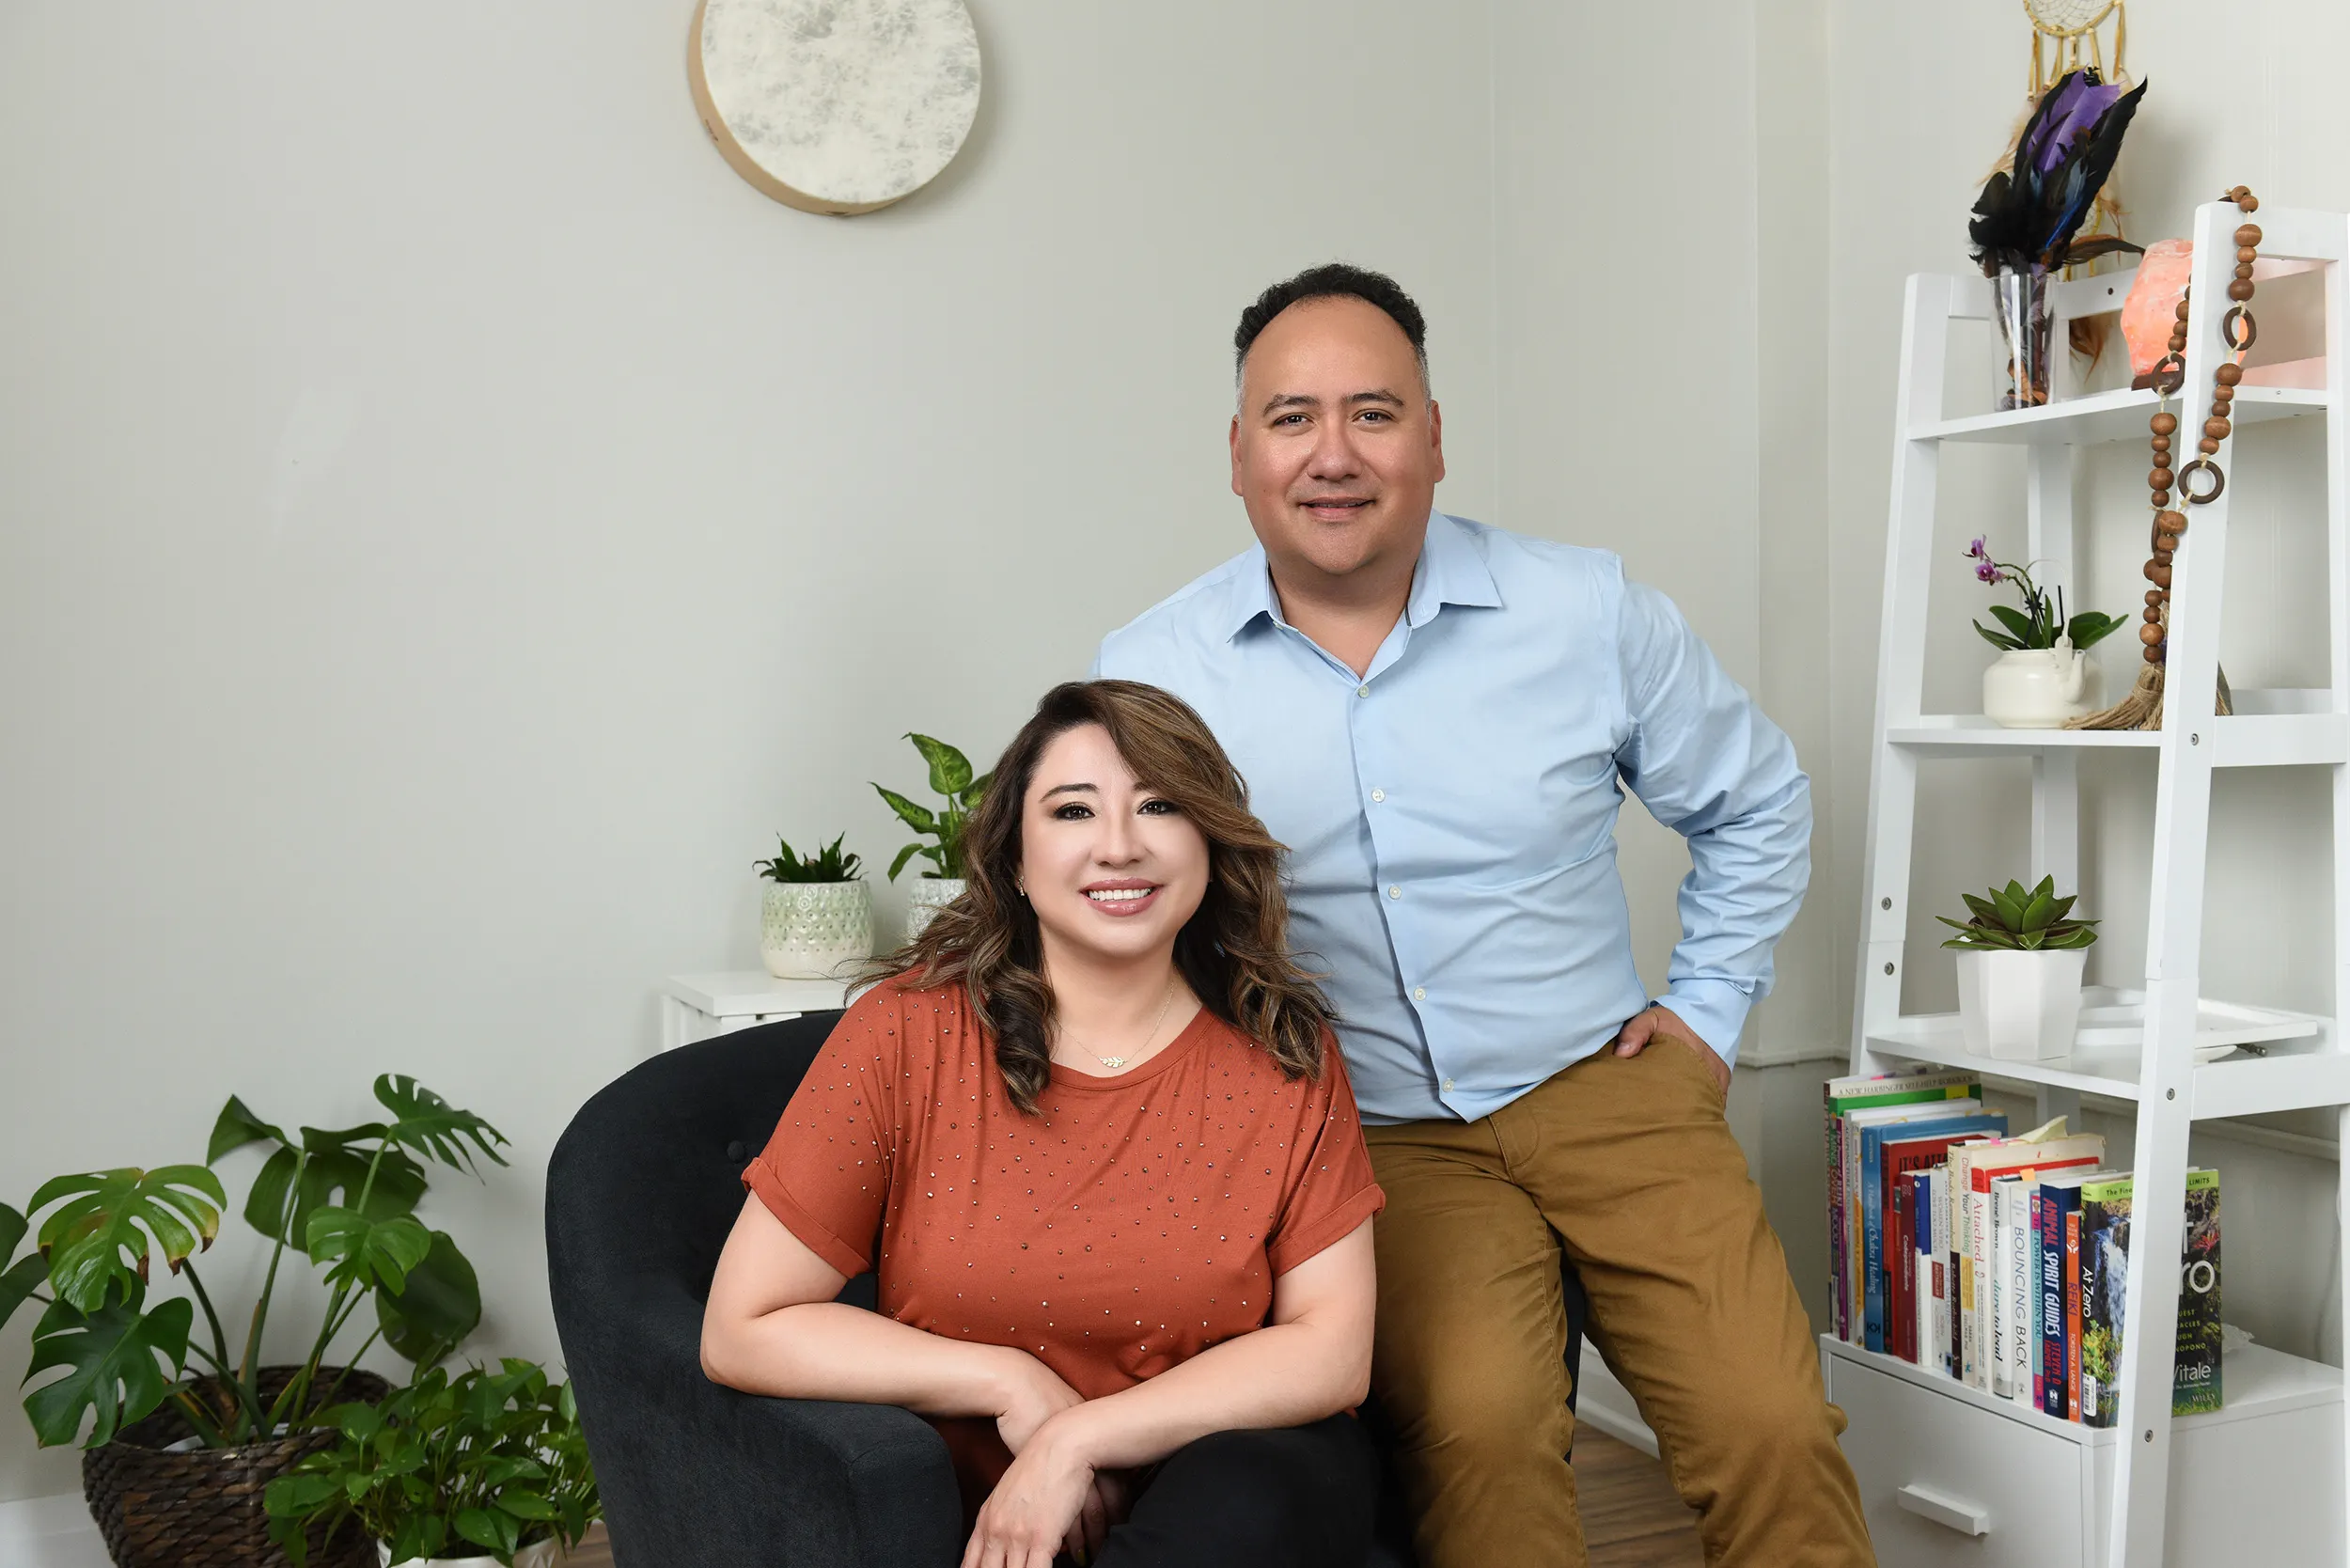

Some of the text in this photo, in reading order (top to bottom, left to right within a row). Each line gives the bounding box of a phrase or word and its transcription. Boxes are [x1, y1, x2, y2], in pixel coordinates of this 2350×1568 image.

[1844, 1087, 1862, 1095] NEW
[1864, 1083, 1904, 1093] HARBINGER
[1899, 1154, 1919, 1172] IT'S
[1961, 1157, 1969, 1191] Change
[2188, 1177, 2210, 1186] LIMITS
[1962, 1193, 1970, 1215] Your
[1868, 1228, 1878, 1260] Chakra
[1962, 1216, 1970, 1253] Thinking
[1973, 1197, 1984, 1266] Attached.
[1867, 1262, 1880, 1294] Healing
[2014, 1226, 2027, 1320] BOUNCING
[2043, 1197, 2060, 1337] ANIMAL SPIRIT GUIDES
[1993, 1279, 2001, 1312] dare
[2068, 1281, 2078, 1316] REIKI
[2082, 1266, 2094, 1318] At Zero
[1994, 1315, 2000, 1328] to
[2180, 1320, 2201, 1328] ACLES
[1995, 1329, 2003, 1362] lead
[2015, 1325, 2027, 1369] BACK
[2051, 1341, 2061, 1375] STEVEN
